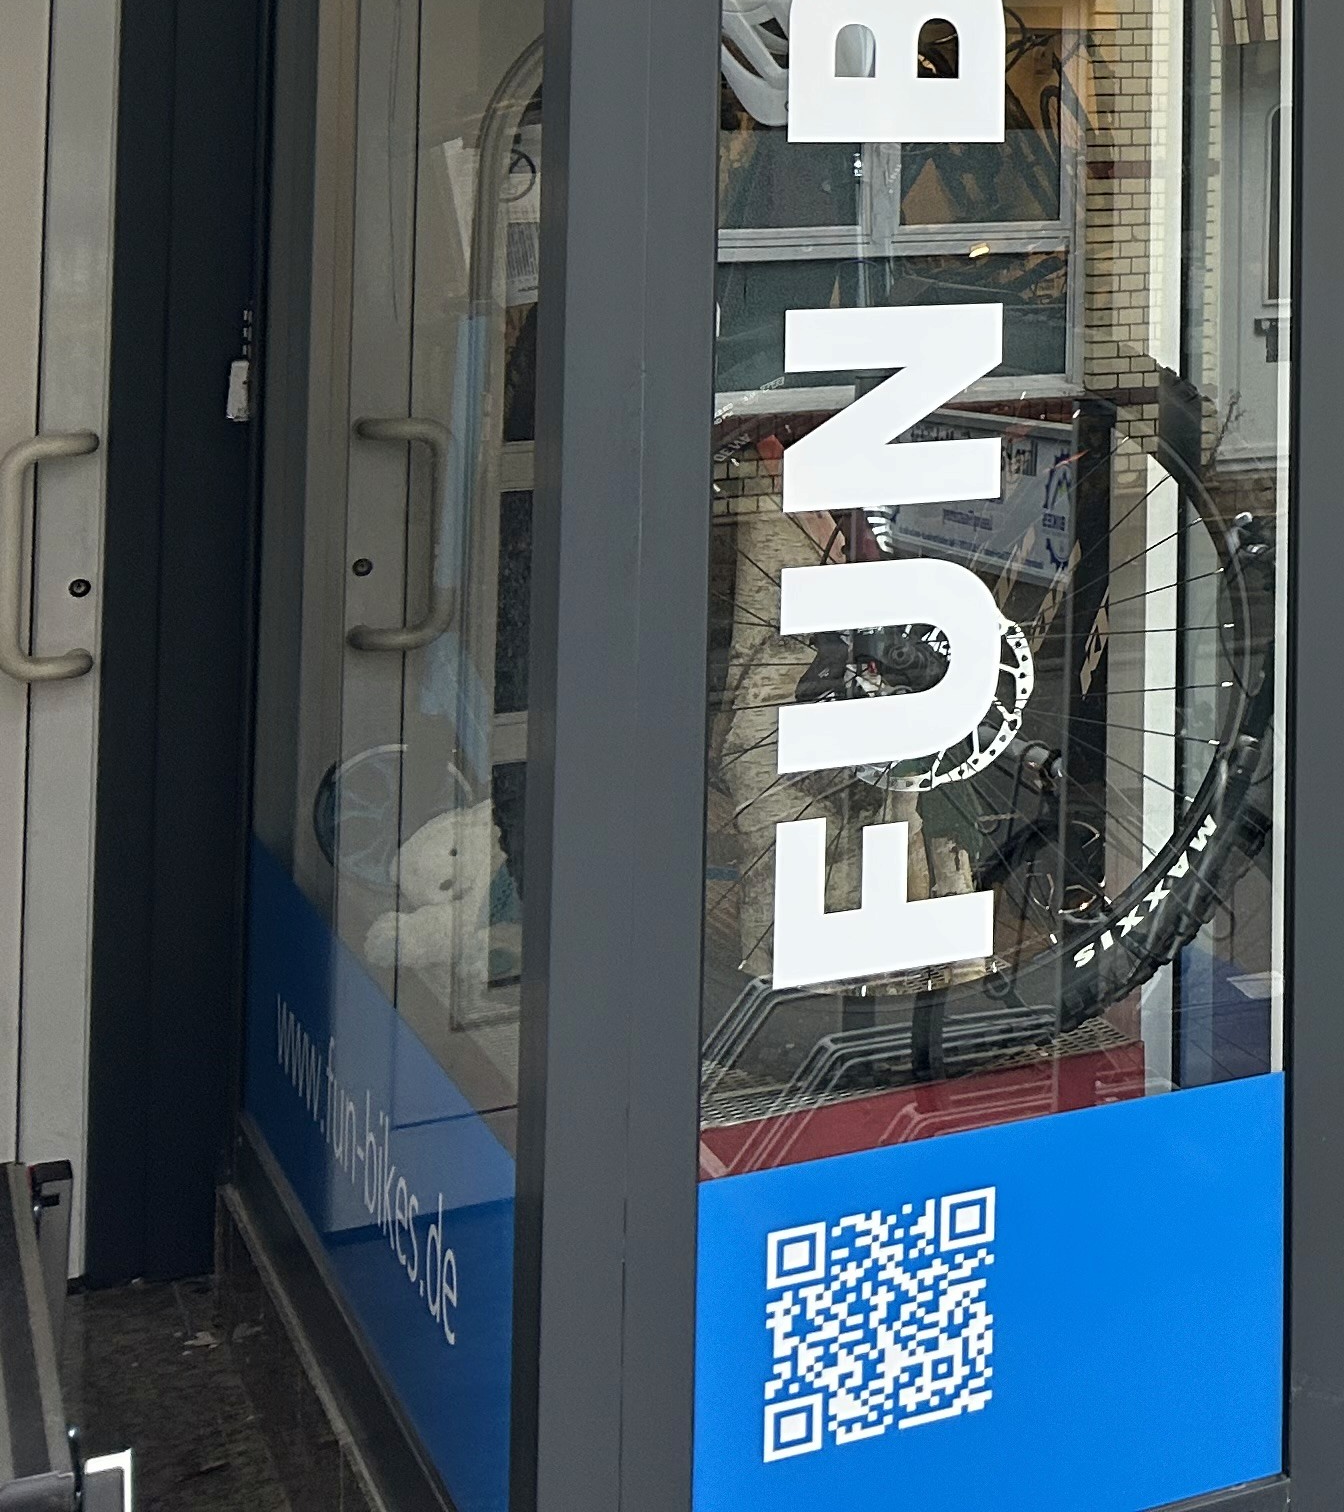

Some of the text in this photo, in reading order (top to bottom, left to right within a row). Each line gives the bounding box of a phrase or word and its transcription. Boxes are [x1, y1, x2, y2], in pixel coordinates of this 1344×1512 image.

[772, 303, 1003, 990] FUN
[1073, 813, 1218, 969] MAXXIS
[276, 992, 458, 1346] www.fun-bikes.de
